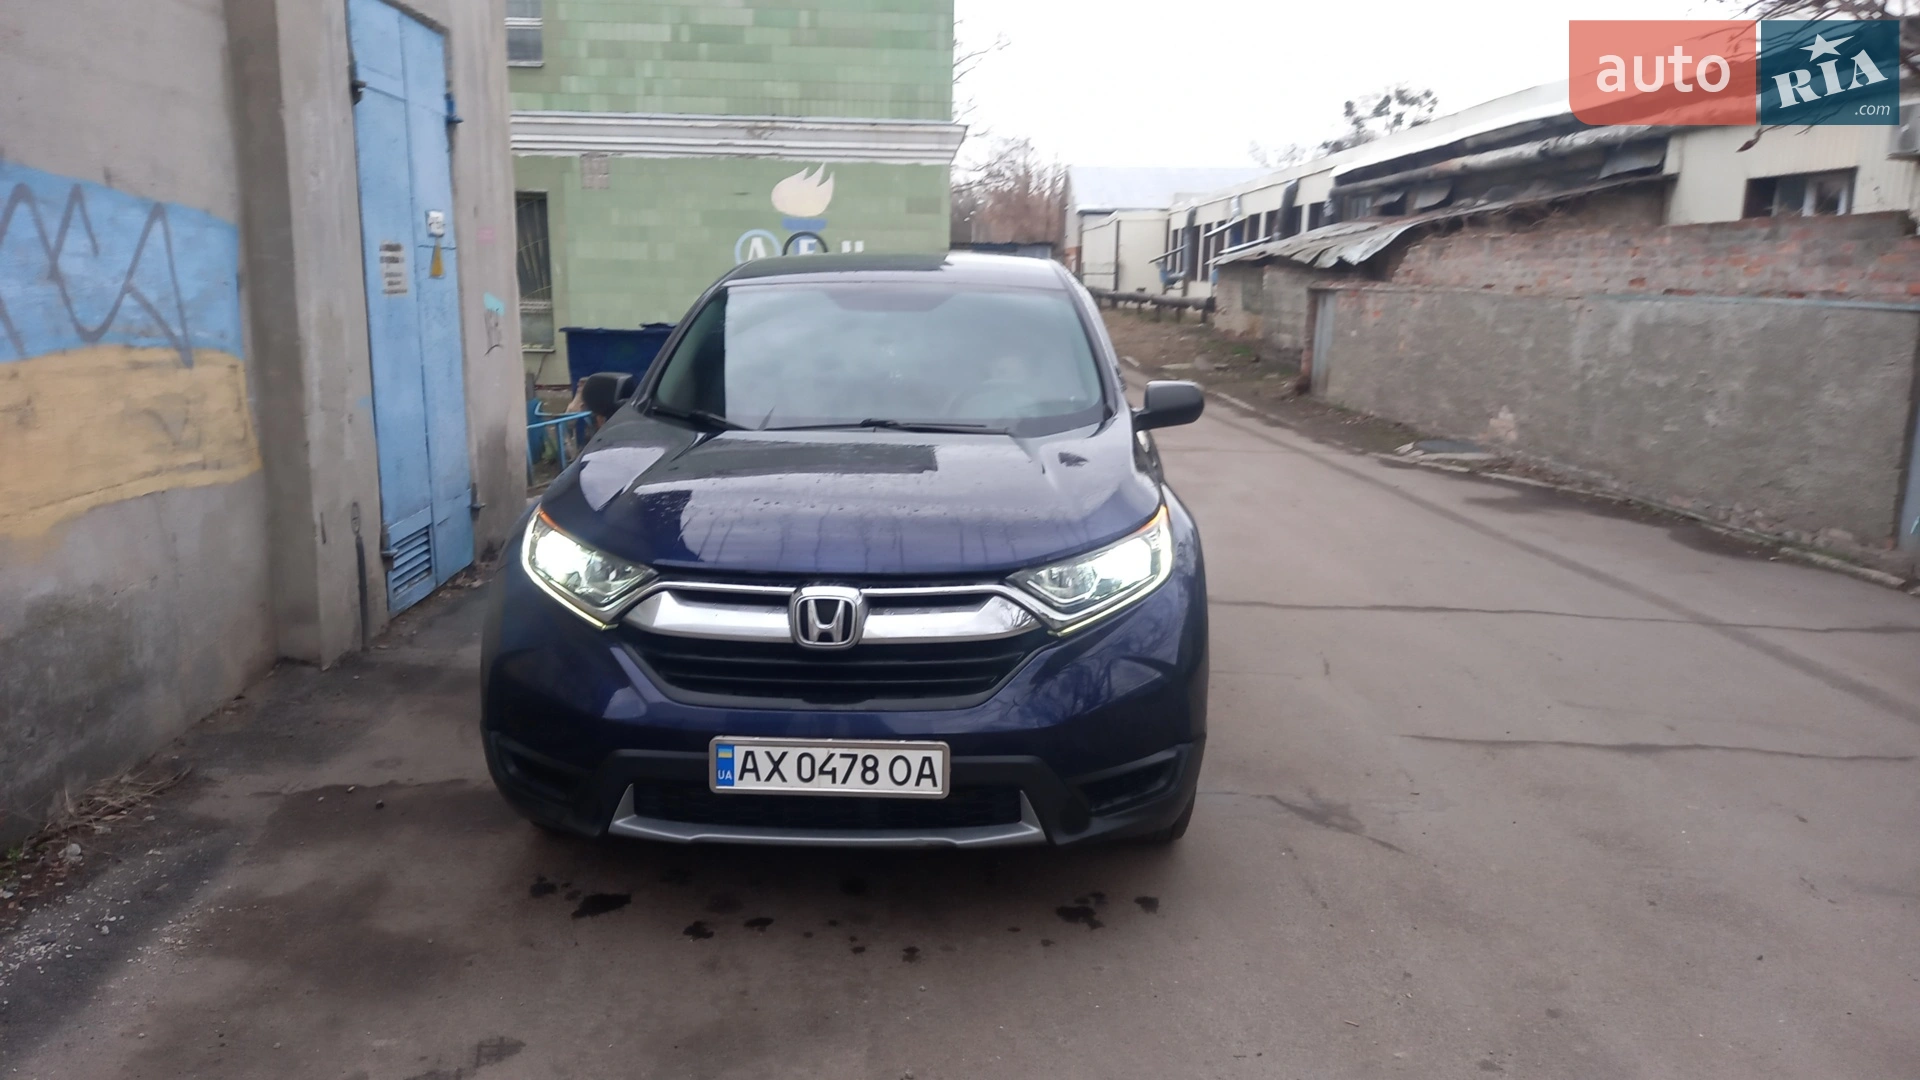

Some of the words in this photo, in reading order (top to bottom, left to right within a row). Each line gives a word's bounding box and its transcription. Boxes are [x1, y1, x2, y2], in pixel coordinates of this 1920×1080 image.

[717, 769, 733, 781] UA
[738, 750, 789, 783] AX
[796, 751, 880, 786] 0478
[889, 754, 938, 788] OA
